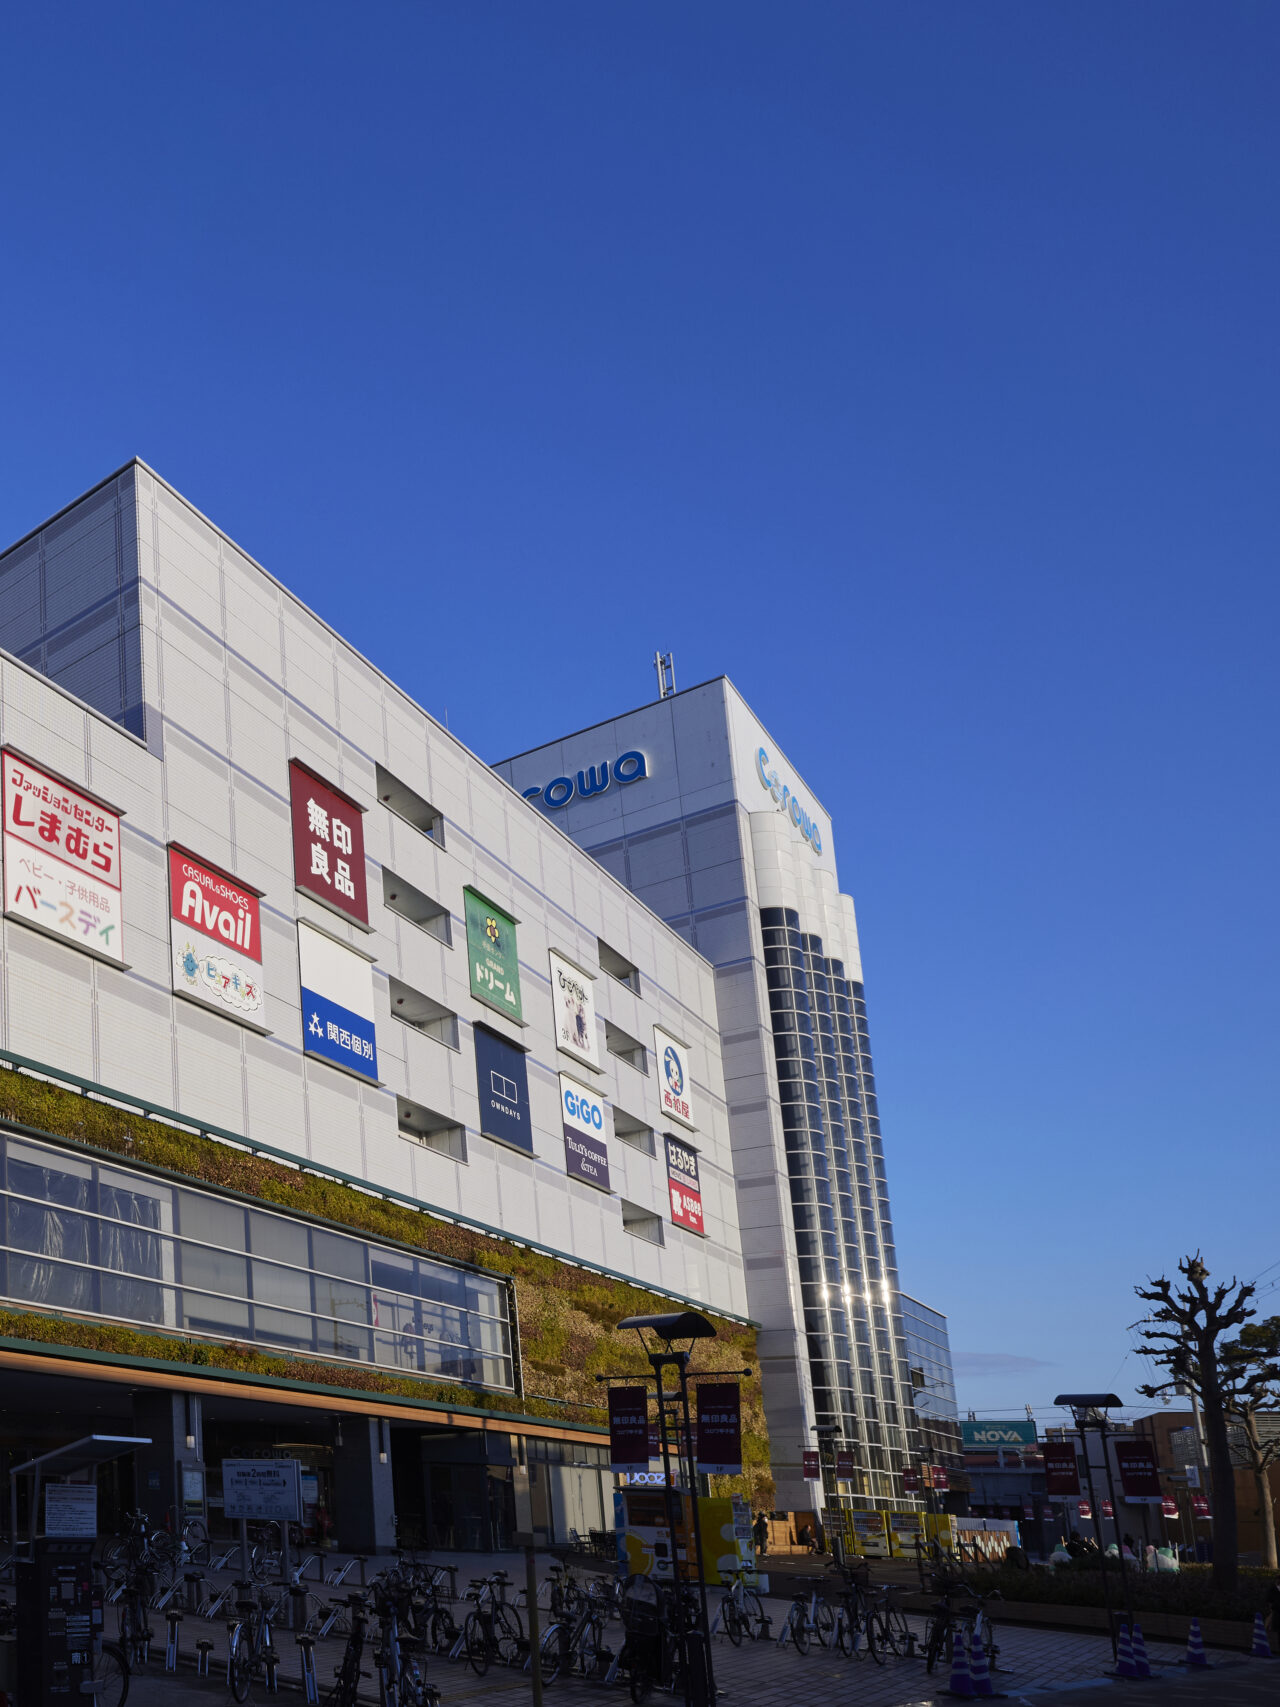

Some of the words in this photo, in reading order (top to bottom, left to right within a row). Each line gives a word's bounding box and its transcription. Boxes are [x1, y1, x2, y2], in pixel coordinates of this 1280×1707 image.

[12, 769, 113, 833] ファッションセンター
[755, 747, 823, 856] Corowa
[13, 793, 114, 873] しまむら
[307, 798, 353, 855] 無印
[19, 858, 111, 914] ベビー・子供用品
[310, 842, 355, 900] 良品
[181, 881, 252, 950] Avail
[476, 962, 516, 1005] ドリーム
[327, 1022, 374, 1062] 関西個別
[491, 1100, 521, 1120] OWNDAYS
[664, 1089, 690, 1119] 西松屋
[587, 1150, 607, 1166] COFFEE
[668, 1142, 696, 1176] はるやま
[973, 1430, 1024, 1442] NOVA
